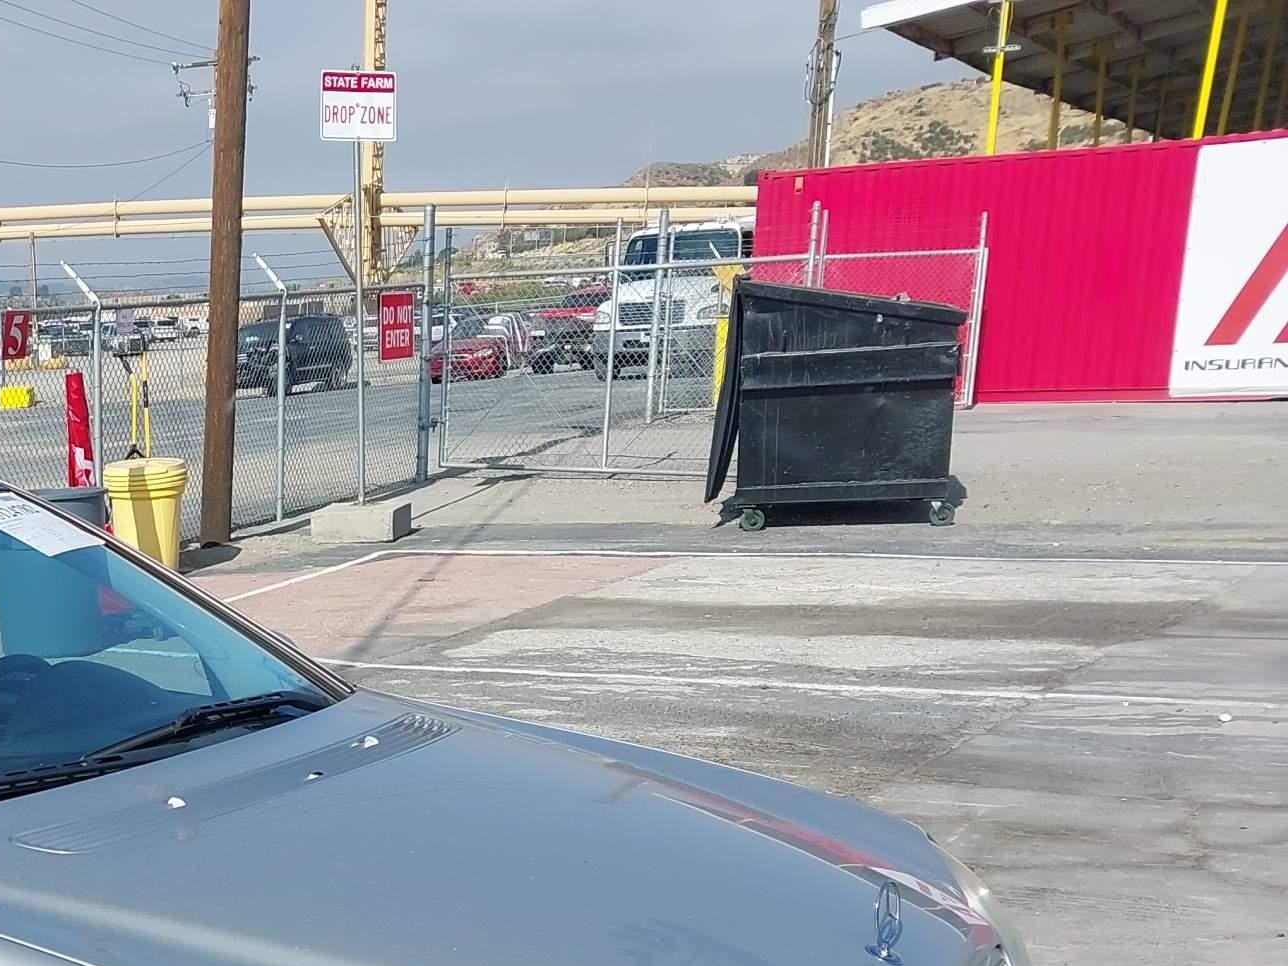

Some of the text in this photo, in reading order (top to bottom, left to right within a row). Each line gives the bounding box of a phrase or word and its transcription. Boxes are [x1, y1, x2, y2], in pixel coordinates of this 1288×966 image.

[324, 75, 393, 89] STATE FARM
[324, 105, 392, 124] DROP ZONE
[383, 305, 412, 324] DO NOT
[7, 315, 25, 355] 5
[385, 329, 409, 348] ENTER
